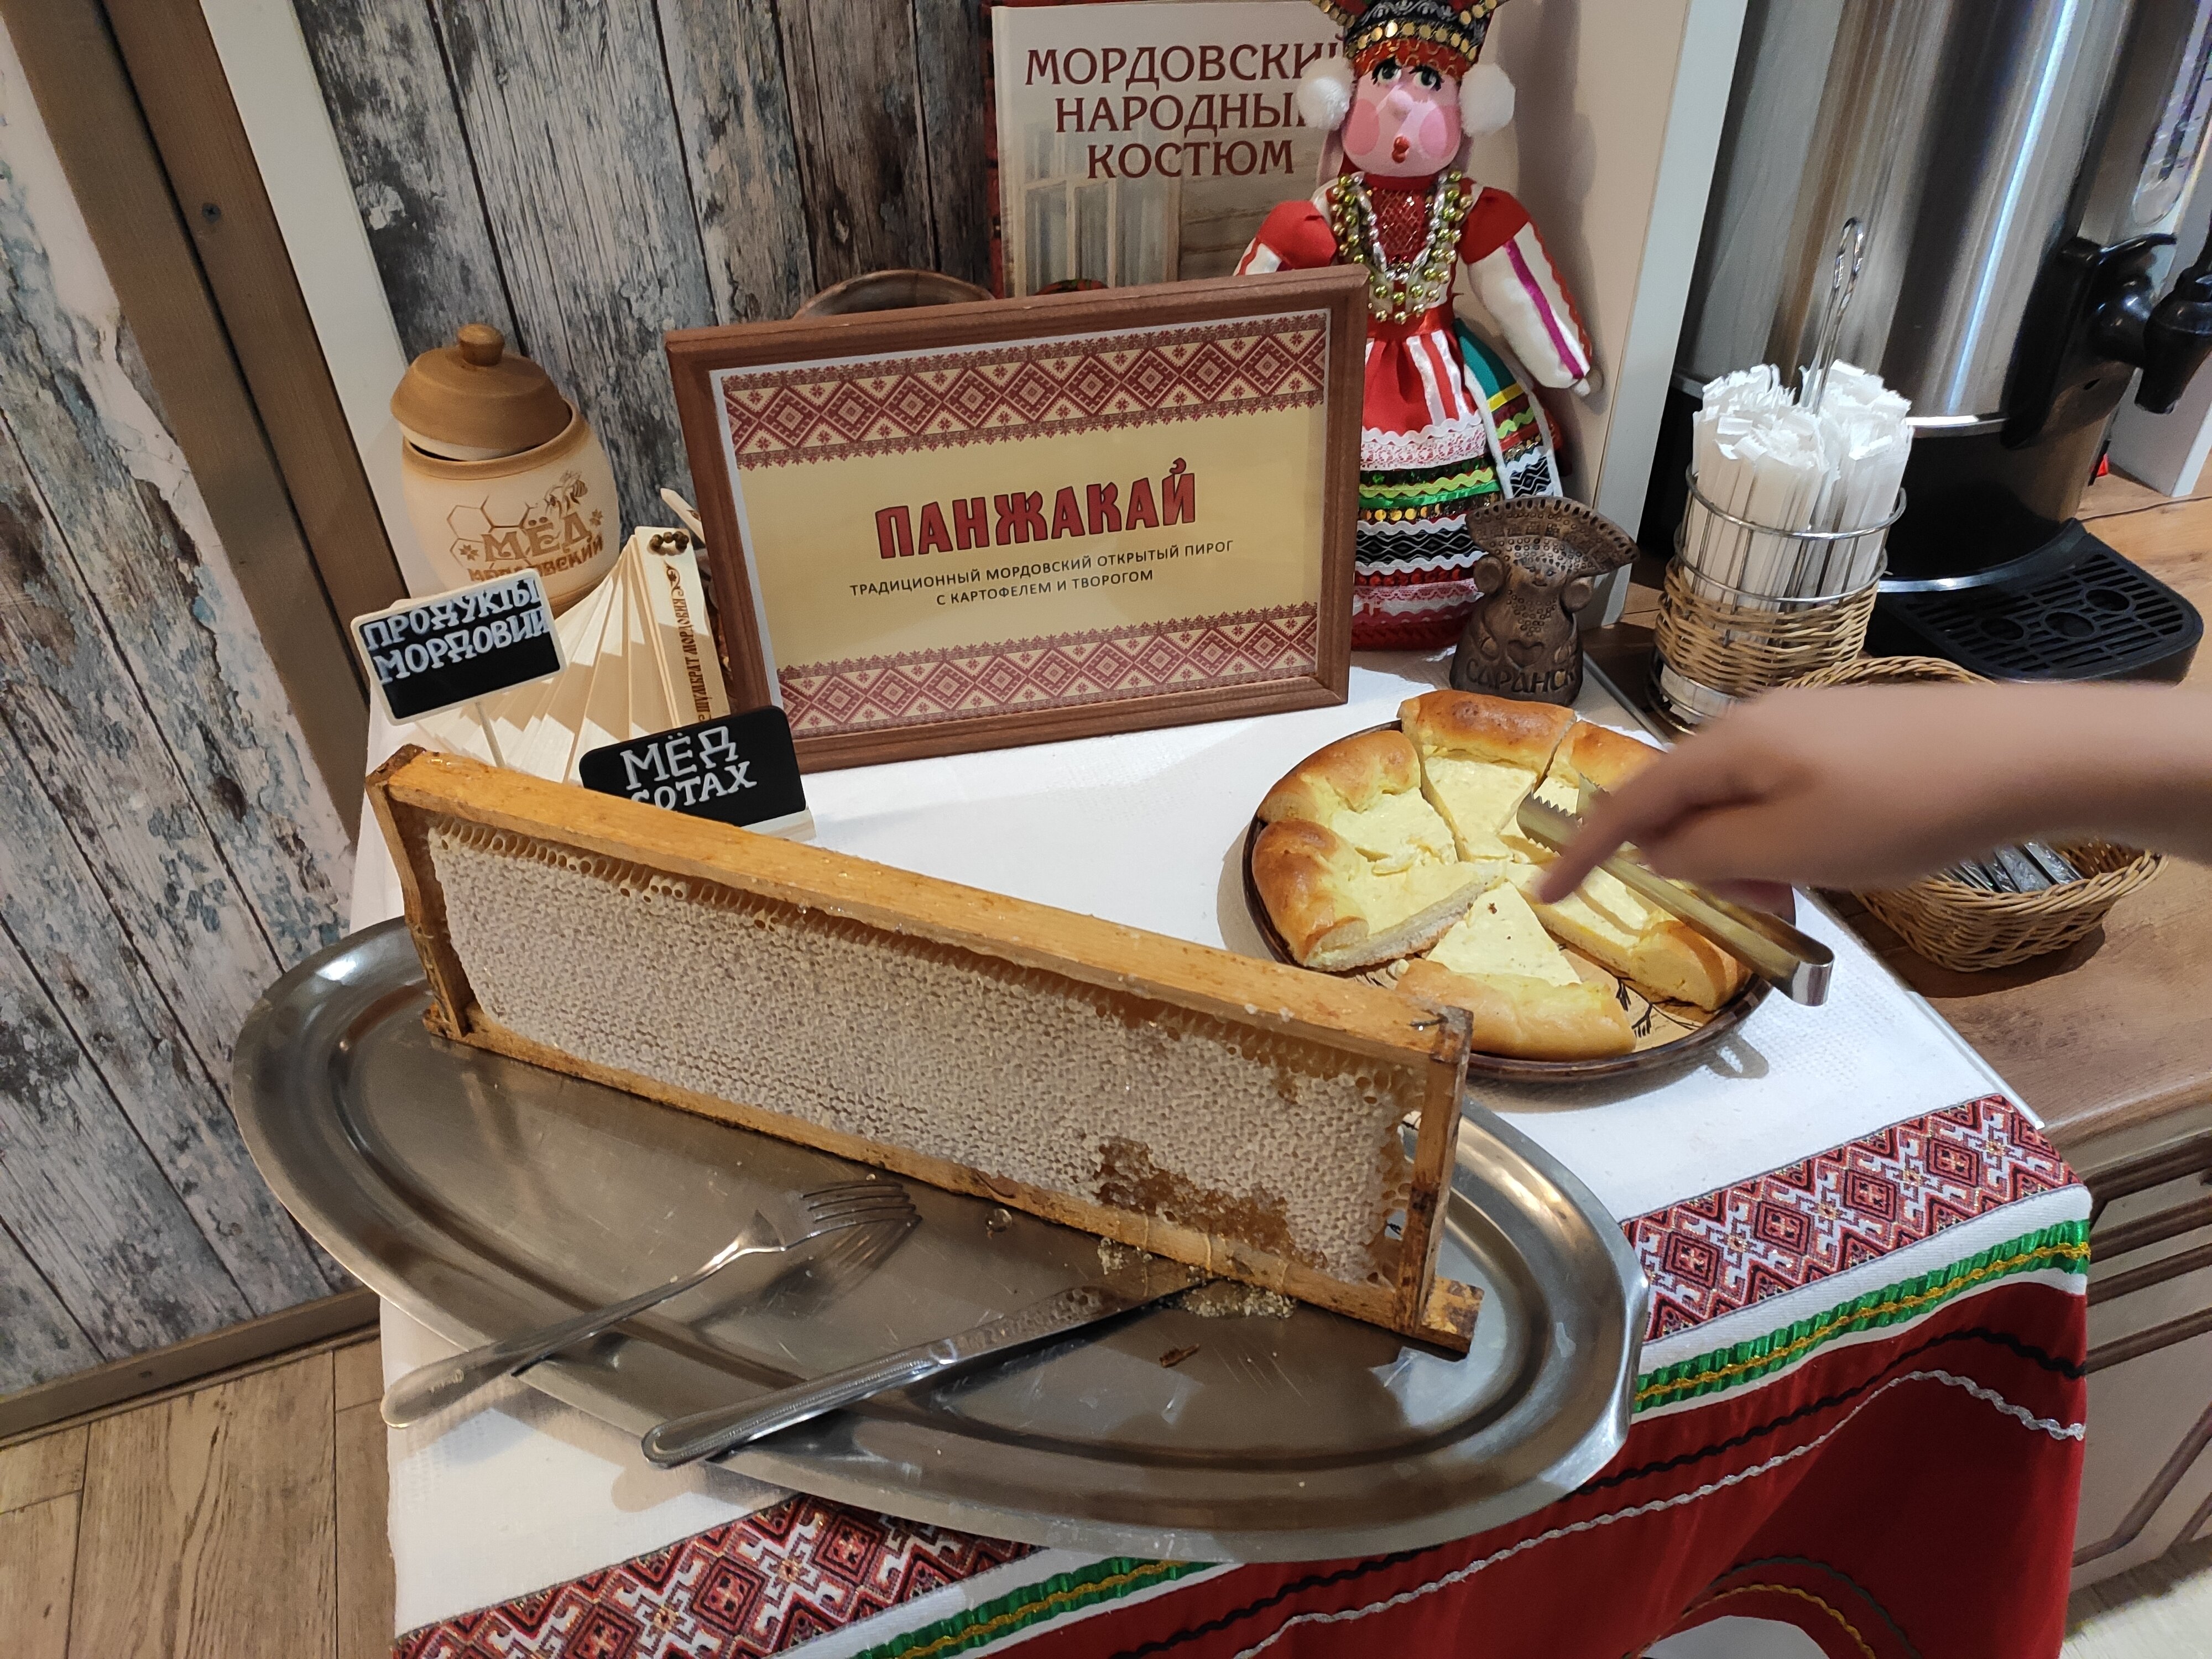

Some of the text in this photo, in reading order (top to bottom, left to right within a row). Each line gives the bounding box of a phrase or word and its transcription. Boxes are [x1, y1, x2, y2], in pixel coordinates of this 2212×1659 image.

[1056, 93, 1306, 138] НАРОДНЫ
[1087, 140, 1294, 179] КОСТЮМ
[481, 512, 592, 562] МЁД
[875, 457, 1196, 559] ПАНЖАКАЙ
[850, 540, 1233, 596] ТРАДИЦИОННЫЙ МОРДОВСКИЙ ОТКРЫТЫЙ ПИРОГ
[936, 570, 1153, 606] С КАРТОФЕЛЕМ И ТВОРОГОМ
[364, 578, 541, 651] ПРОДУКТЫ
[373, 607, 551, 685] МОРДОВИИ
[672, 598, 712, 713] ШУМБРАТ МОРДОВИЯ
[620, 726, 739, 790] МЁД
